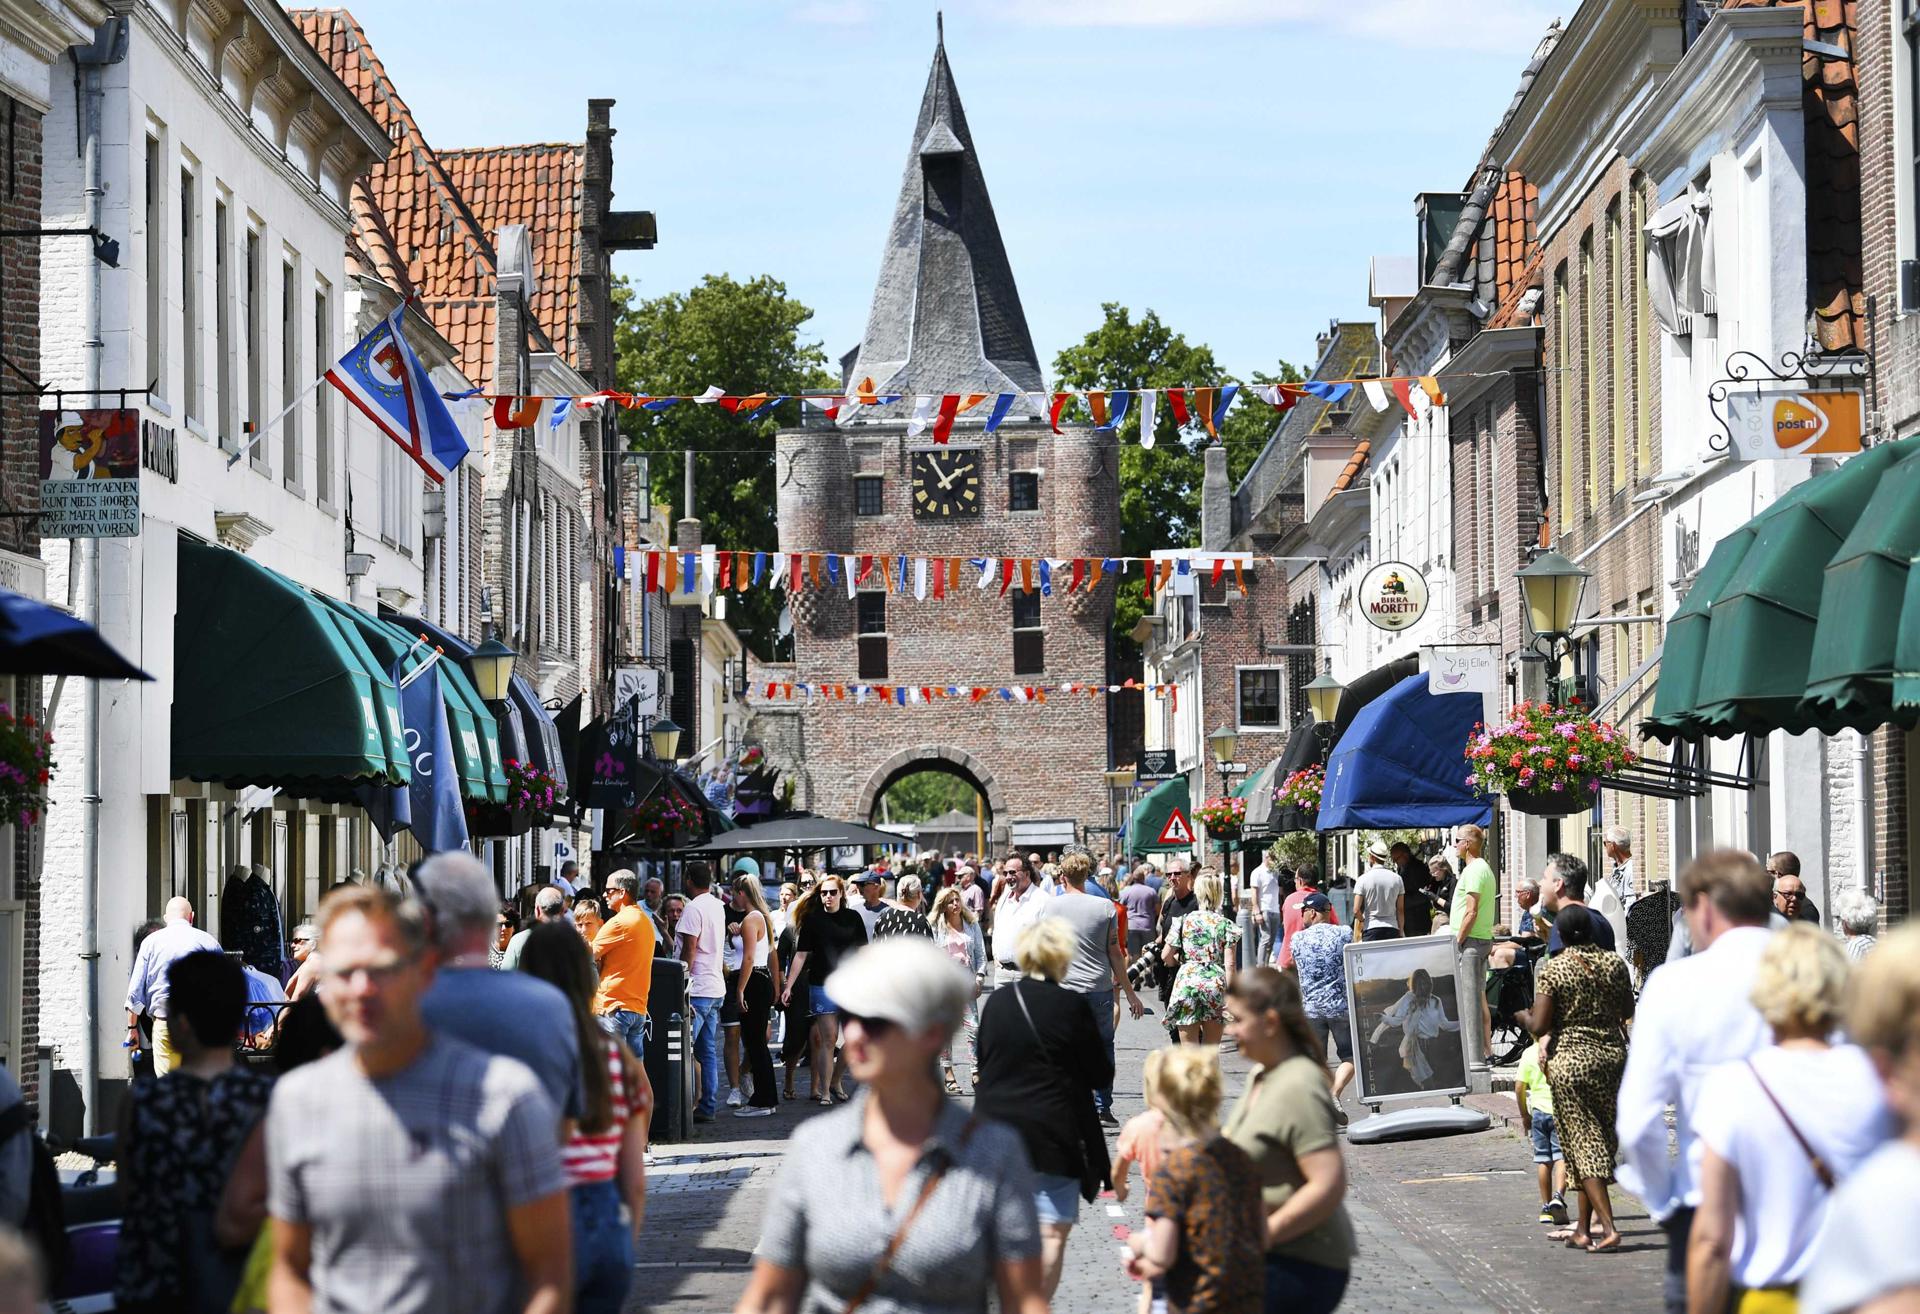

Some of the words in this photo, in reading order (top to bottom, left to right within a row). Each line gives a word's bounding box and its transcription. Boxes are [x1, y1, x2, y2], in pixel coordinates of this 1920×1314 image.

[1776, 417, 1817, 432] postnl
[43, 483, 58, 494] GY
[87, 482, 101, 493] MY
[42, 496, 68, 508] KUNT
[100, 495, 139, 508] HOOREN
[69, 510, 99, 522] MAER
[99, 510, 109, 520] IN
[110, 509, 137, 520] HUYS
[41, 524, 59, 535] WY
[61, 523, 95, 535] KOMEN
[97, 523, 134, 535] VOREN
[1370, 601, 1418, 614] MORETTI
[1458, 658, 1469, 671] Bij
[1471, 657, 1490, 668] Ellen
